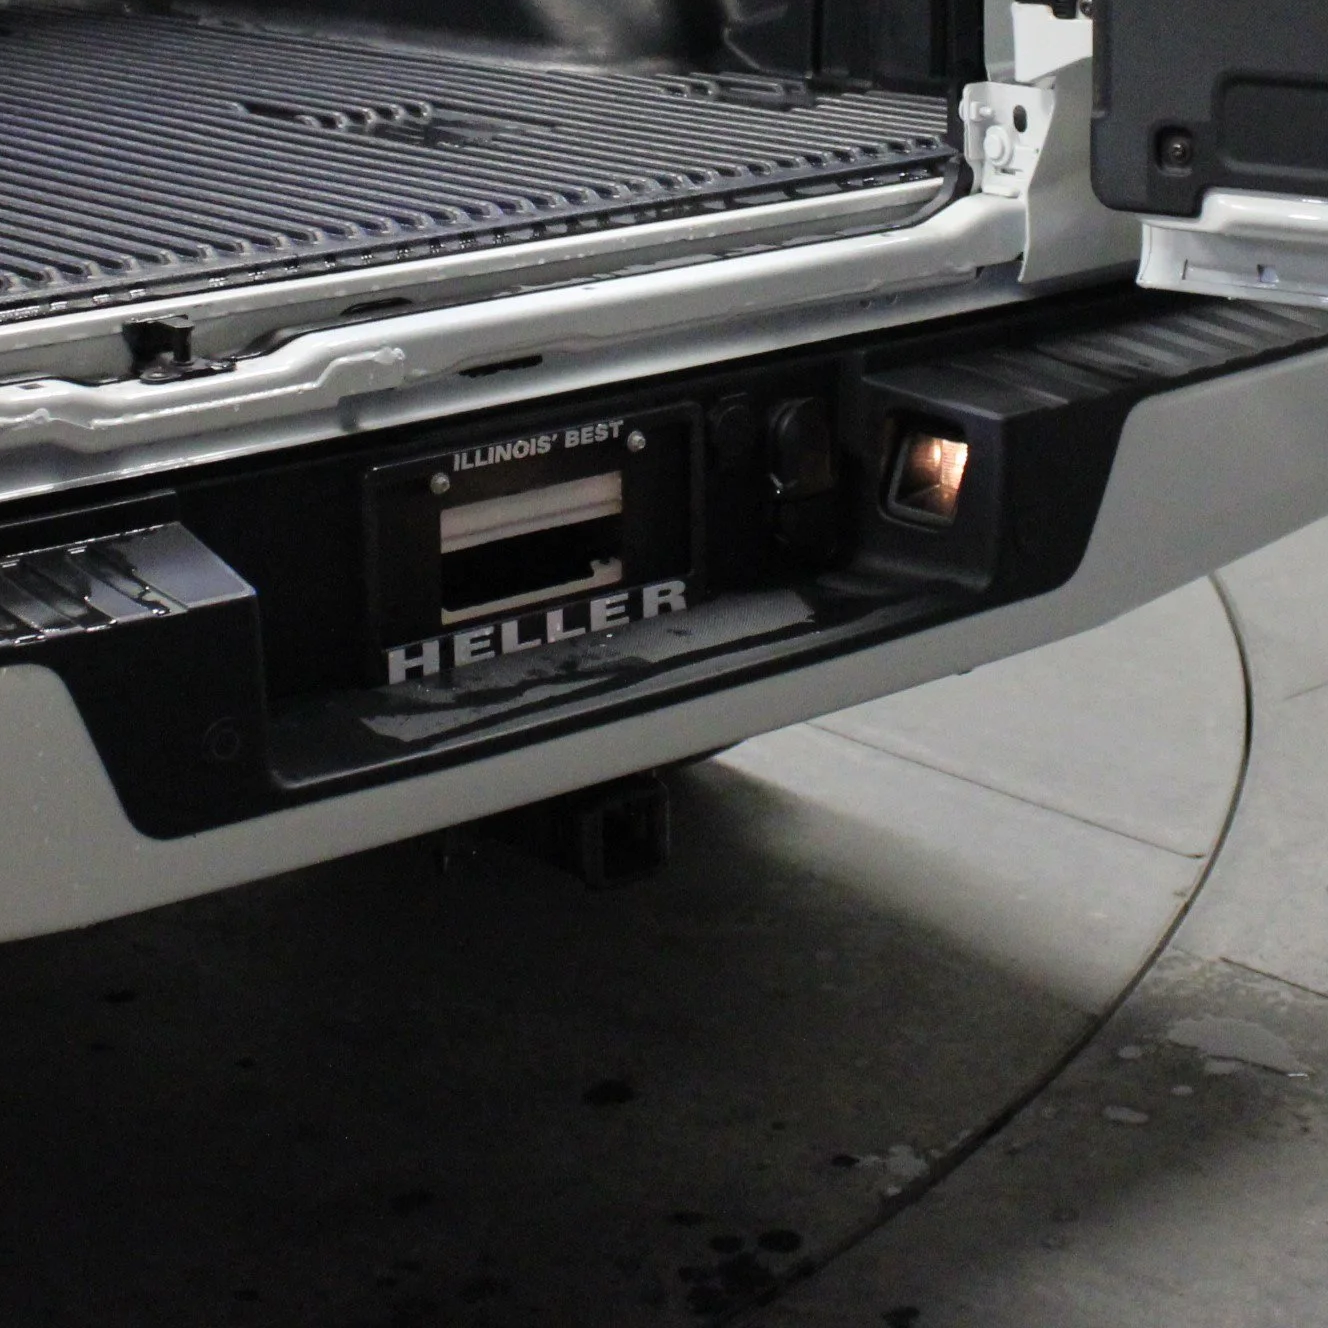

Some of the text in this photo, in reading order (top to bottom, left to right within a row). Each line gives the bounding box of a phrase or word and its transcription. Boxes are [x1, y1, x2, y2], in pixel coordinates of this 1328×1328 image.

[453, 420, 624, 472] ILLINOIS' BEST
[388, 580, 688, 685] HELLER
